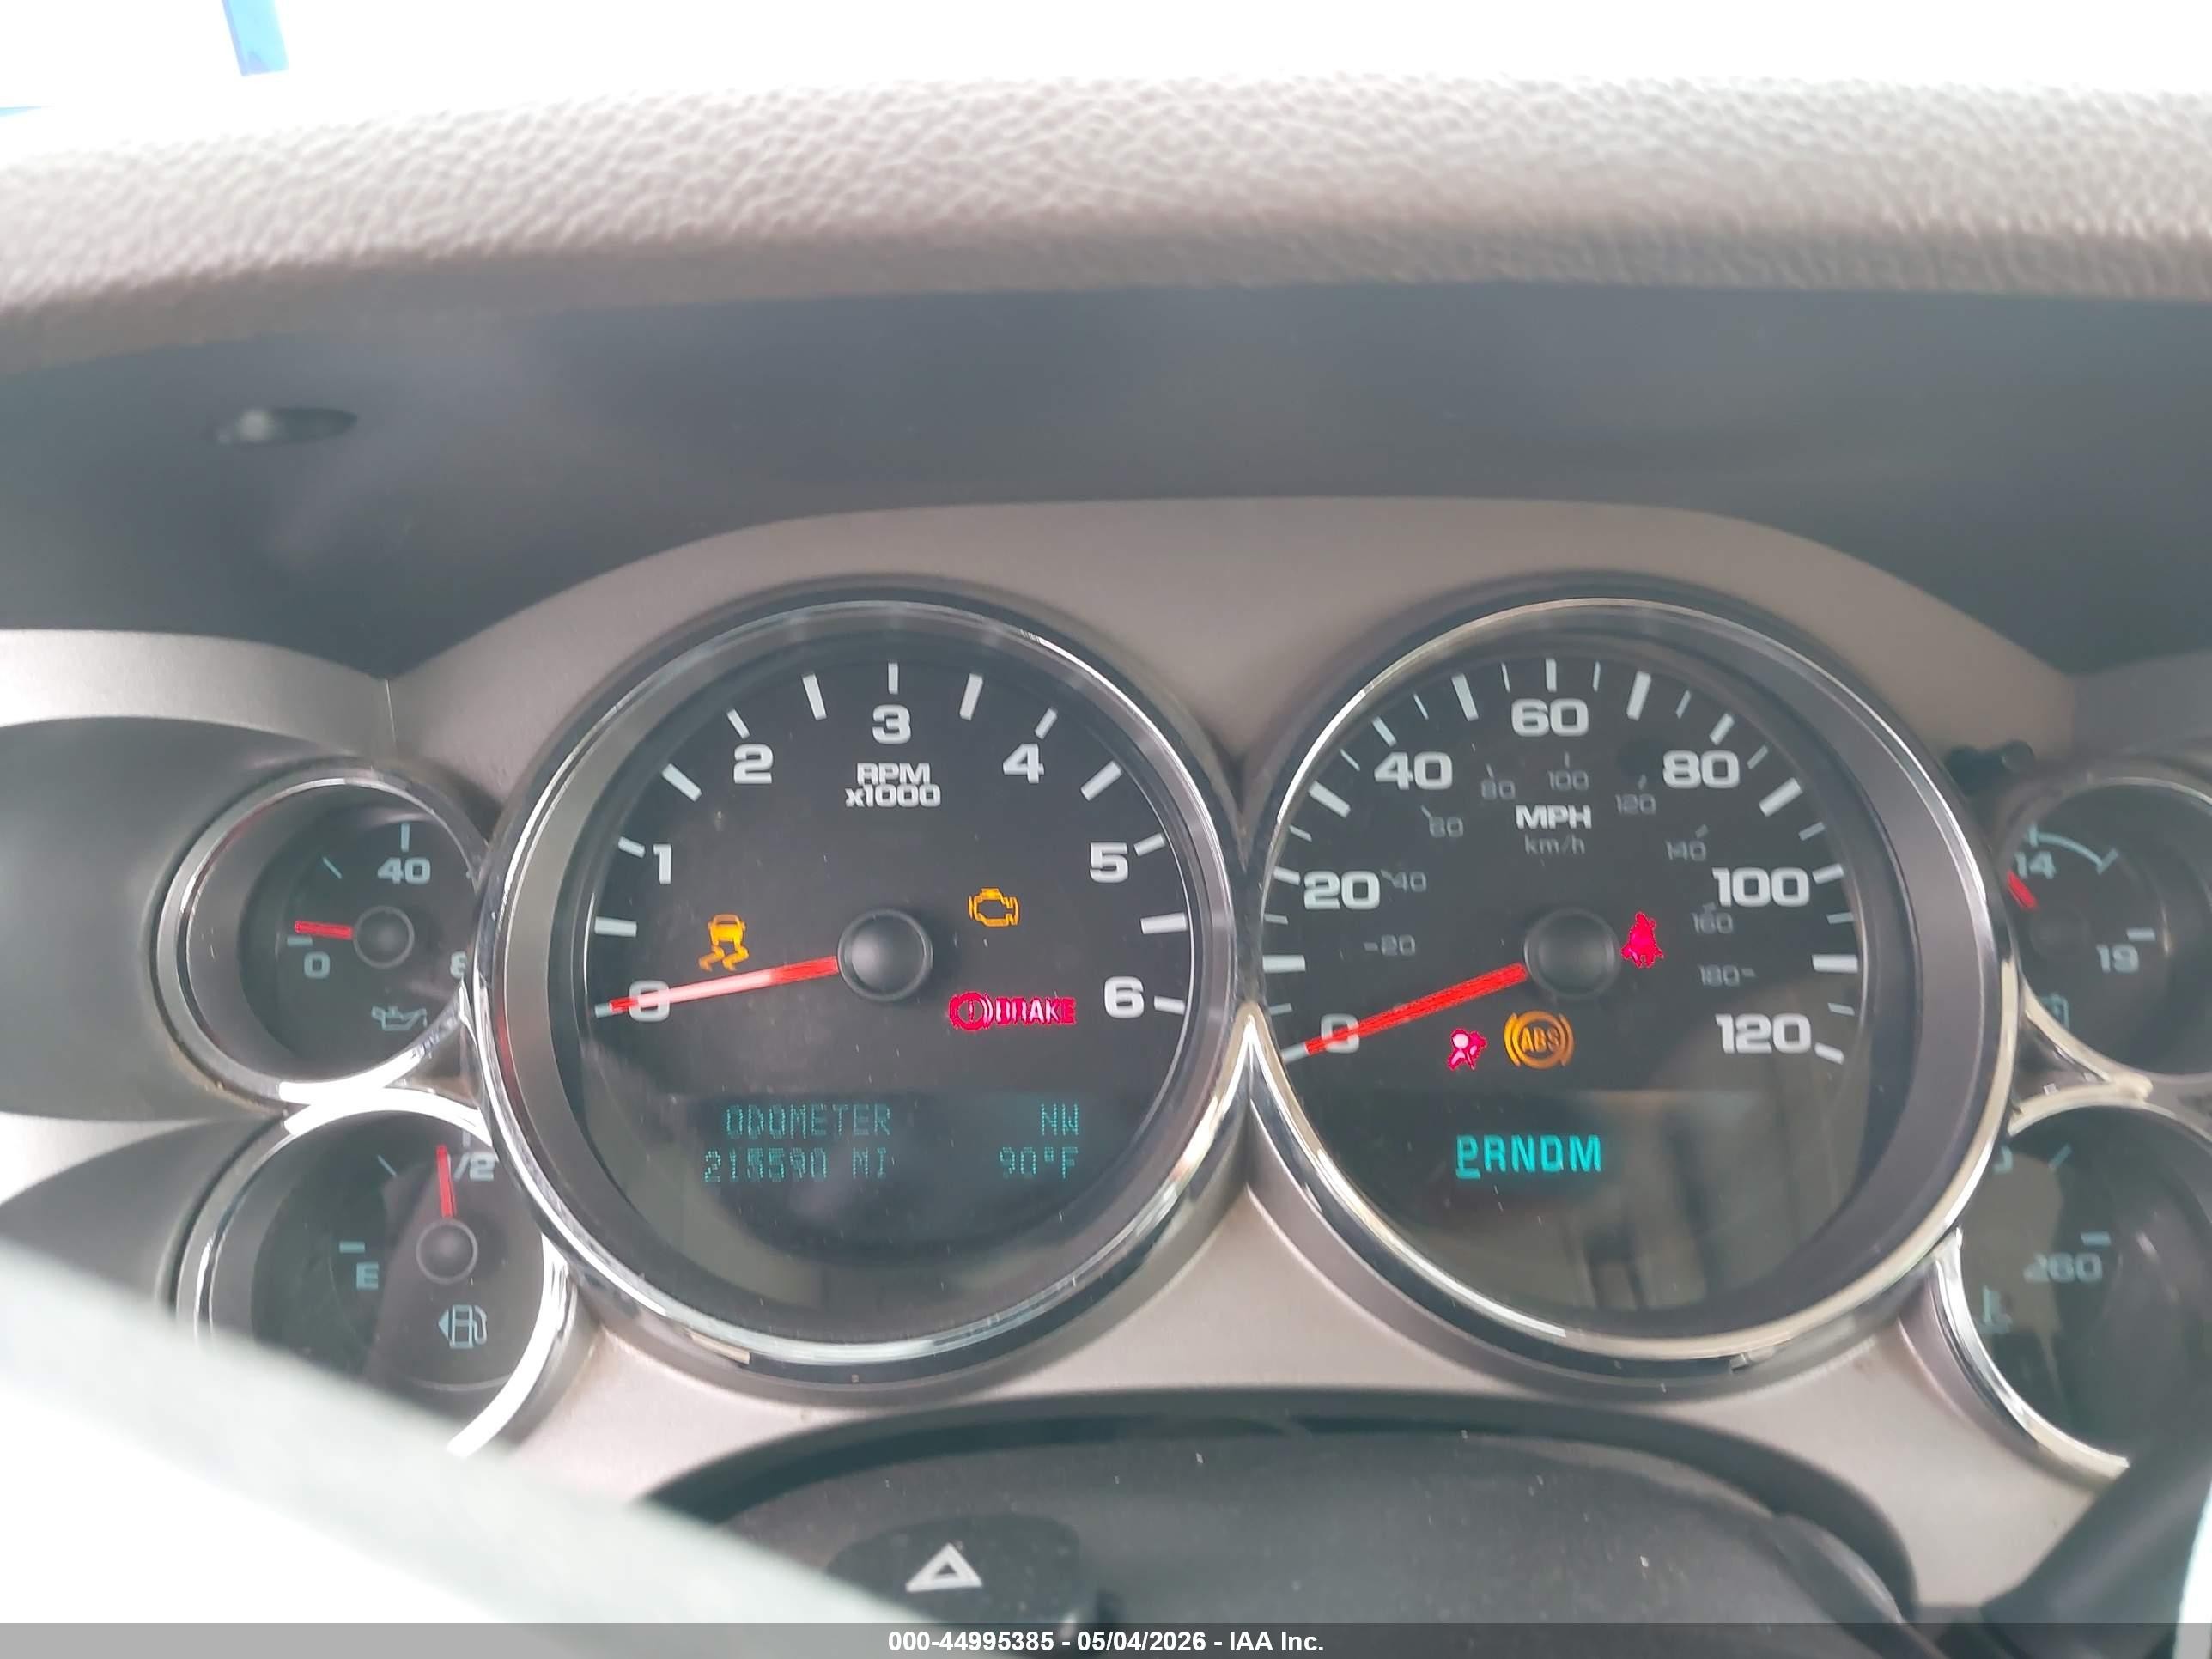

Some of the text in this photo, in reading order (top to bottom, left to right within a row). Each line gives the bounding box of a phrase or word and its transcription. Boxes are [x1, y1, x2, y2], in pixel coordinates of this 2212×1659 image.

[872, 704, 910, 744] 3
[1511, 698, 1589, 737] 60
[733, 744, 773, 784] 2
[857, 763, 930, 785] RPM
[1003, 743, 1044, 783] 4
[1374, 751, 1453, 790] 40
[1548, 771, 1589, 791] 100
[1662, 750, 1740, 788] 80
[845, 784, 941, 807] x1000
[1516, 805, 1592, 830] MPH
[1089, 842, 1129, 883] 5
[1524, 835, 1585, 854] km/h
[377, 858, 431, 884] 40
[653, 844, 672, 884] 1
[1393, 872, 1427, 892] 40
[2015, 851, 2056, 879] 14
[1304, 871, 1381, 910] 20
[1712, 867, 1810, 907] 100
[304, 952, 331, 979] 0
[2096, 944, 2139, 973] 19
[629, 981, 670, 1022] 0
[1104, 976, 1145, 1018] 6
[1320, 1013, 1359, 1054] 0
[1522, 1027, 1560, 1052] ABS
[1716, 1013, 1811, 1054] 120
[726, 1104, 890, 1139] ODOMETER
[1040, 1104, 1079, 1135] NW
[852, 1147, 887, 1179] MI
[1456, 1134, 1601, 1175] PRNDM
[356, 1262, 379, 1288] E
